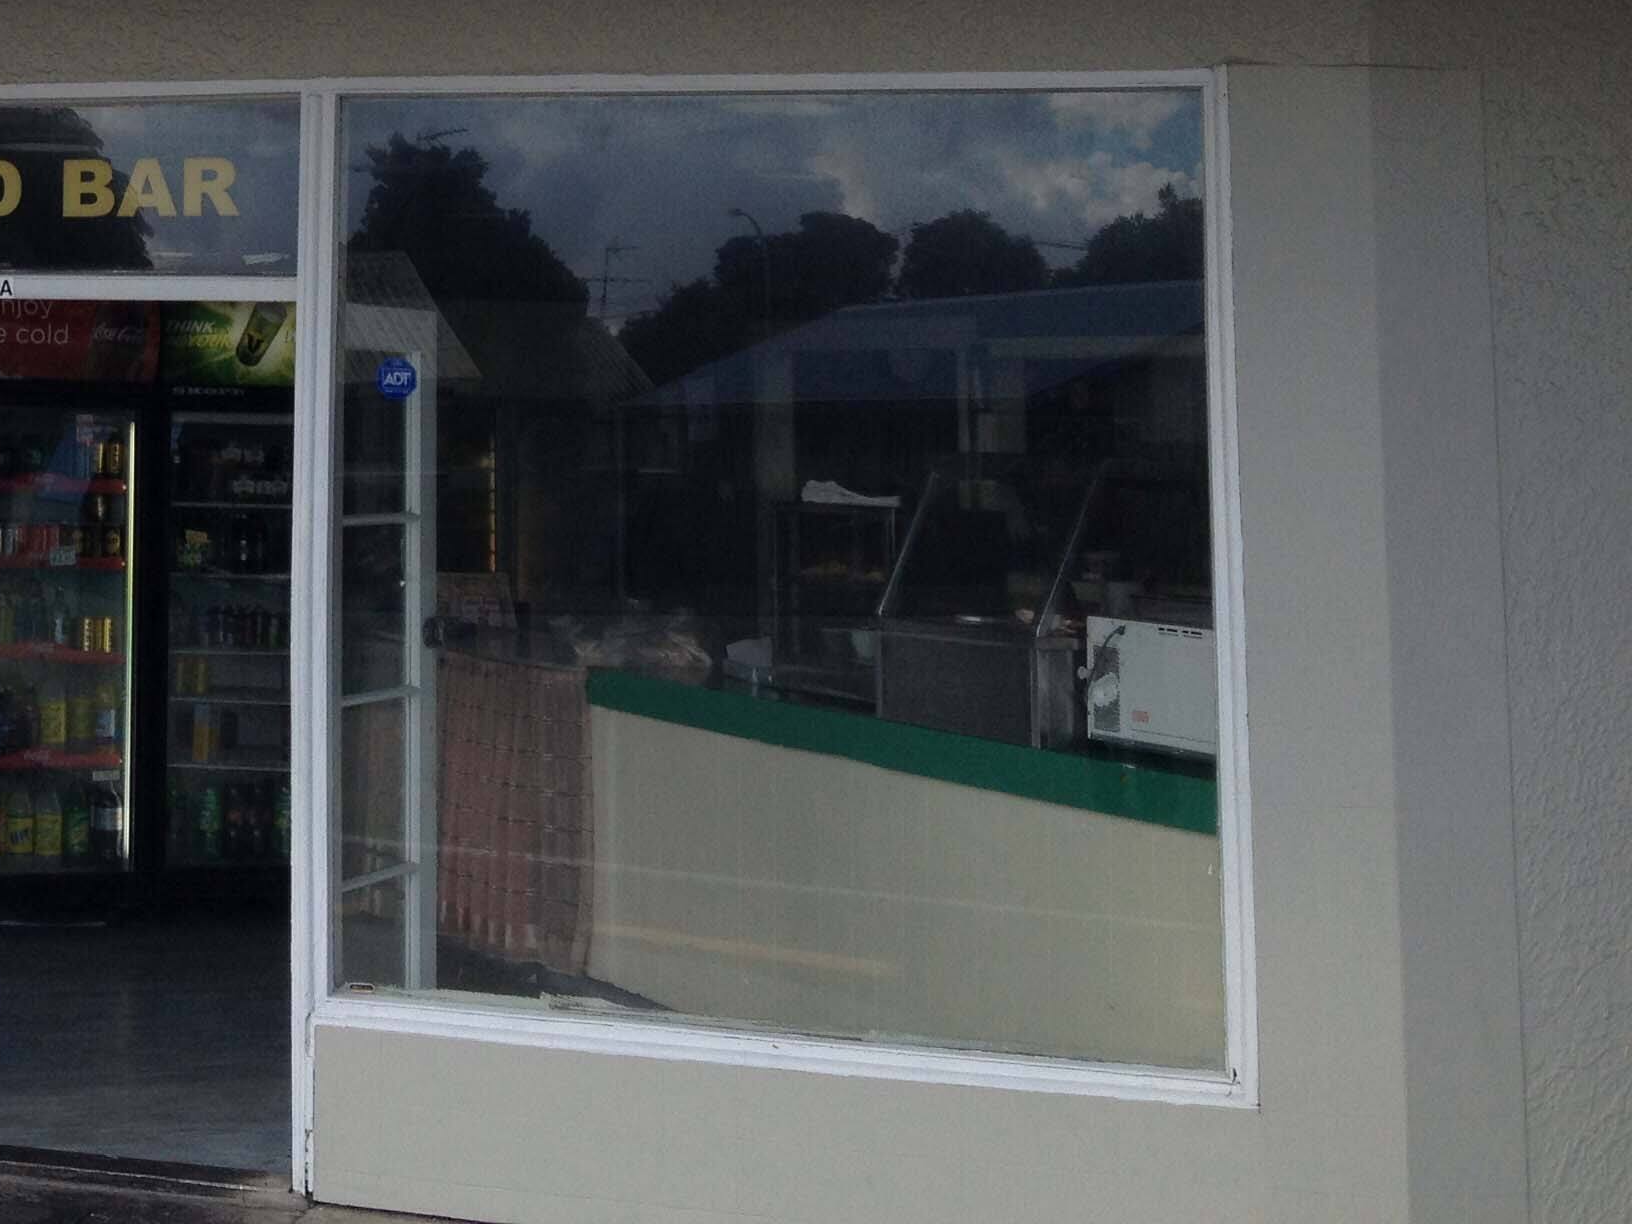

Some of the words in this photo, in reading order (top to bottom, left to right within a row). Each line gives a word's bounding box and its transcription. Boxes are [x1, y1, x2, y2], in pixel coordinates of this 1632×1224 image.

[62, 157, 240, 218] BAR
[16, 322, 70, 345] cold
[383, 371, 411, 387] ADT
